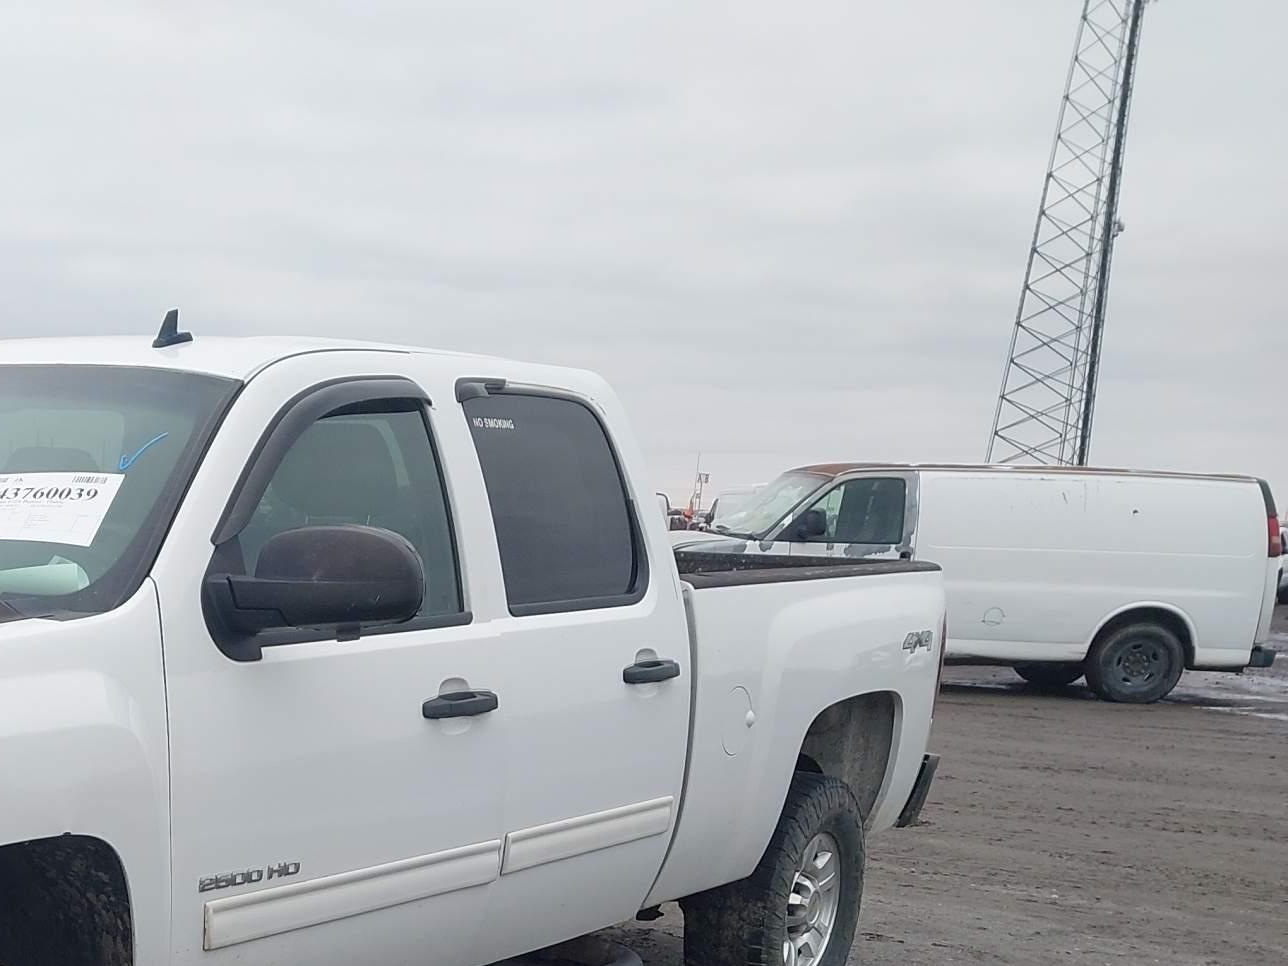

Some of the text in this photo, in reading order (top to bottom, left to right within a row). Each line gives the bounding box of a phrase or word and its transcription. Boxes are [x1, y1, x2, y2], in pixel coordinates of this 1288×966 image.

[472, 417, 514, 429] NO SMOKING
[198, 869, 264, 893] 2500
